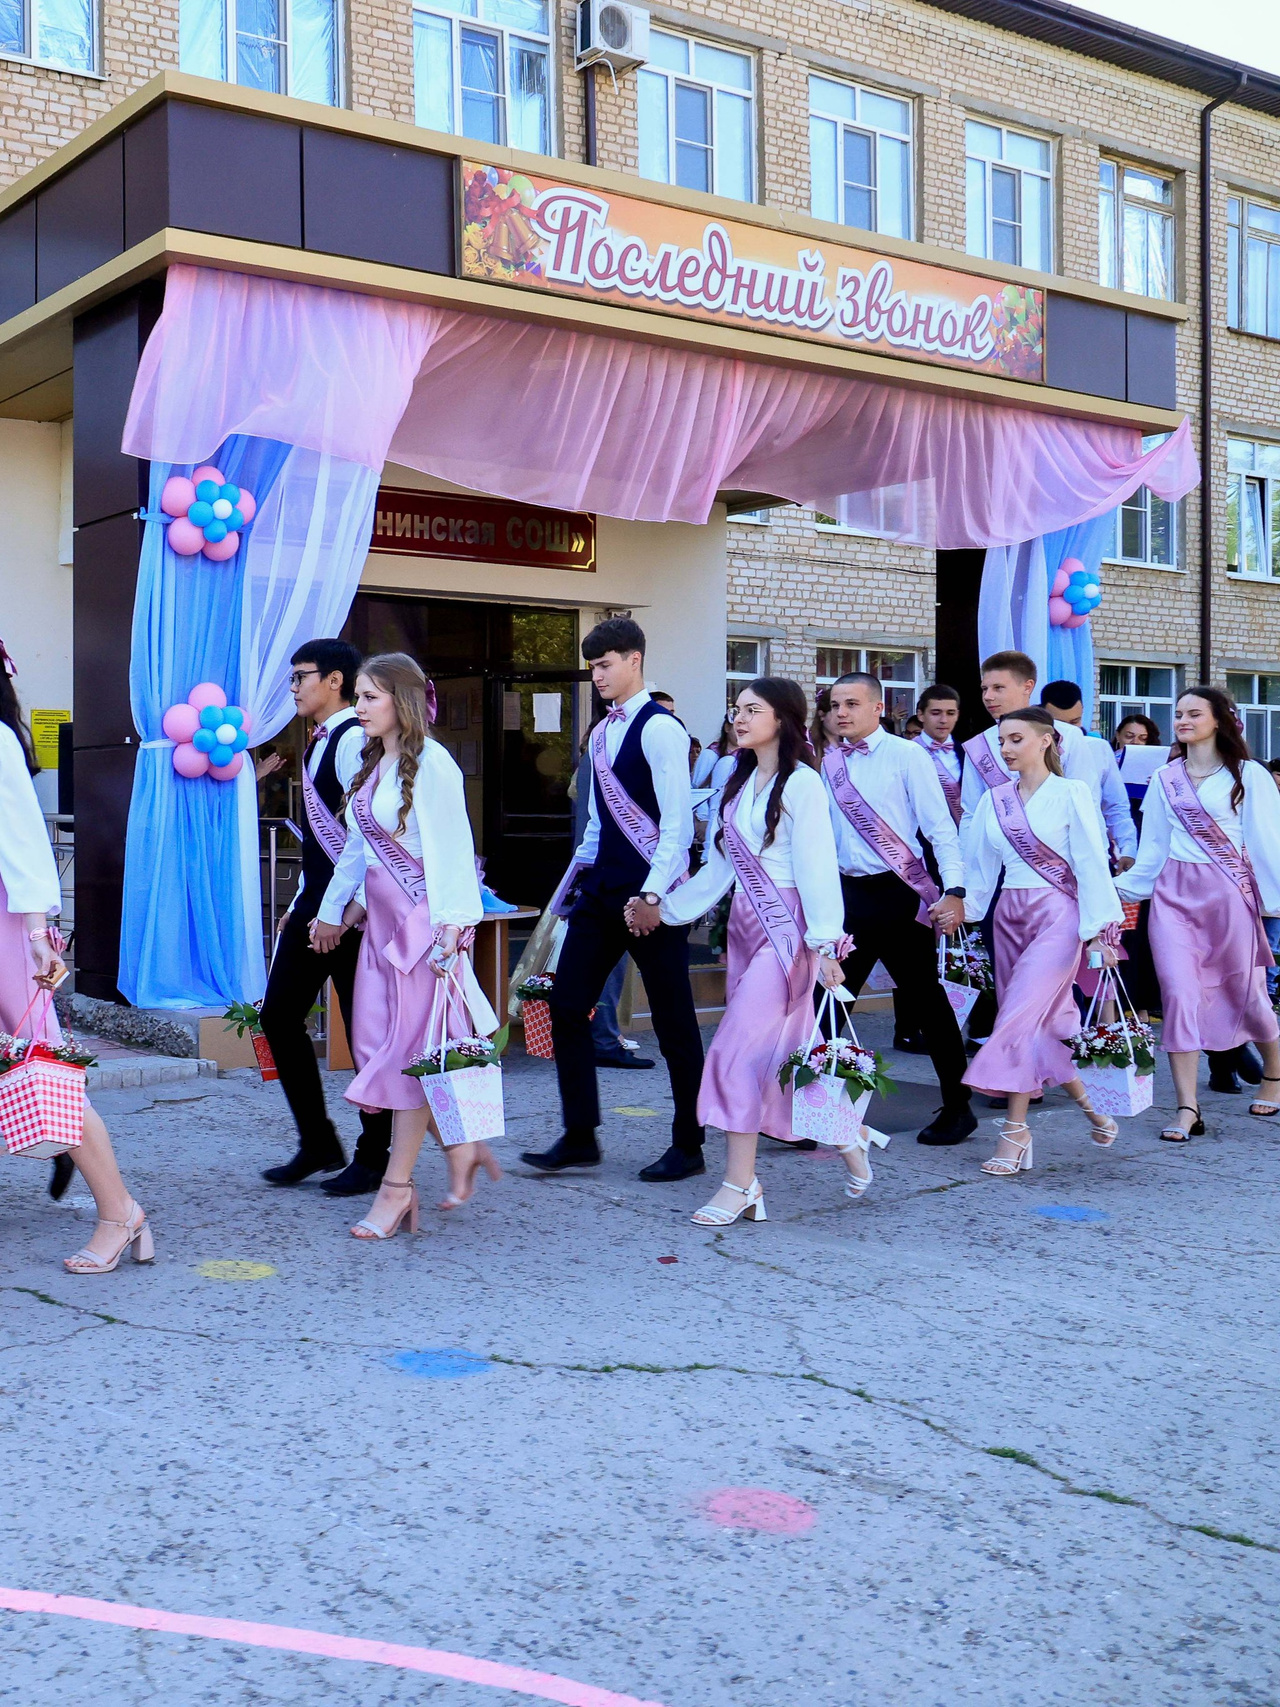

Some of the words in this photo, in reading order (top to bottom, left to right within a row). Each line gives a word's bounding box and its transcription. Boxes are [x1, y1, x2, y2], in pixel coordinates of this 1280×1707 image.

[536, 189, 826, 323] Последний
[840, 261, 990, 356] звонок
[376, 510, 495, 546] нинская
[599, 768, 644, 834] Выпускник
[841, 798, 904, 861] Выпускник
[357, 797, 412, 875] Выпускница
[403, 870, 426, 896] 202
[1180, 806, 1239, 870] Выпускница
[757, 895, 792, 930] 2024
